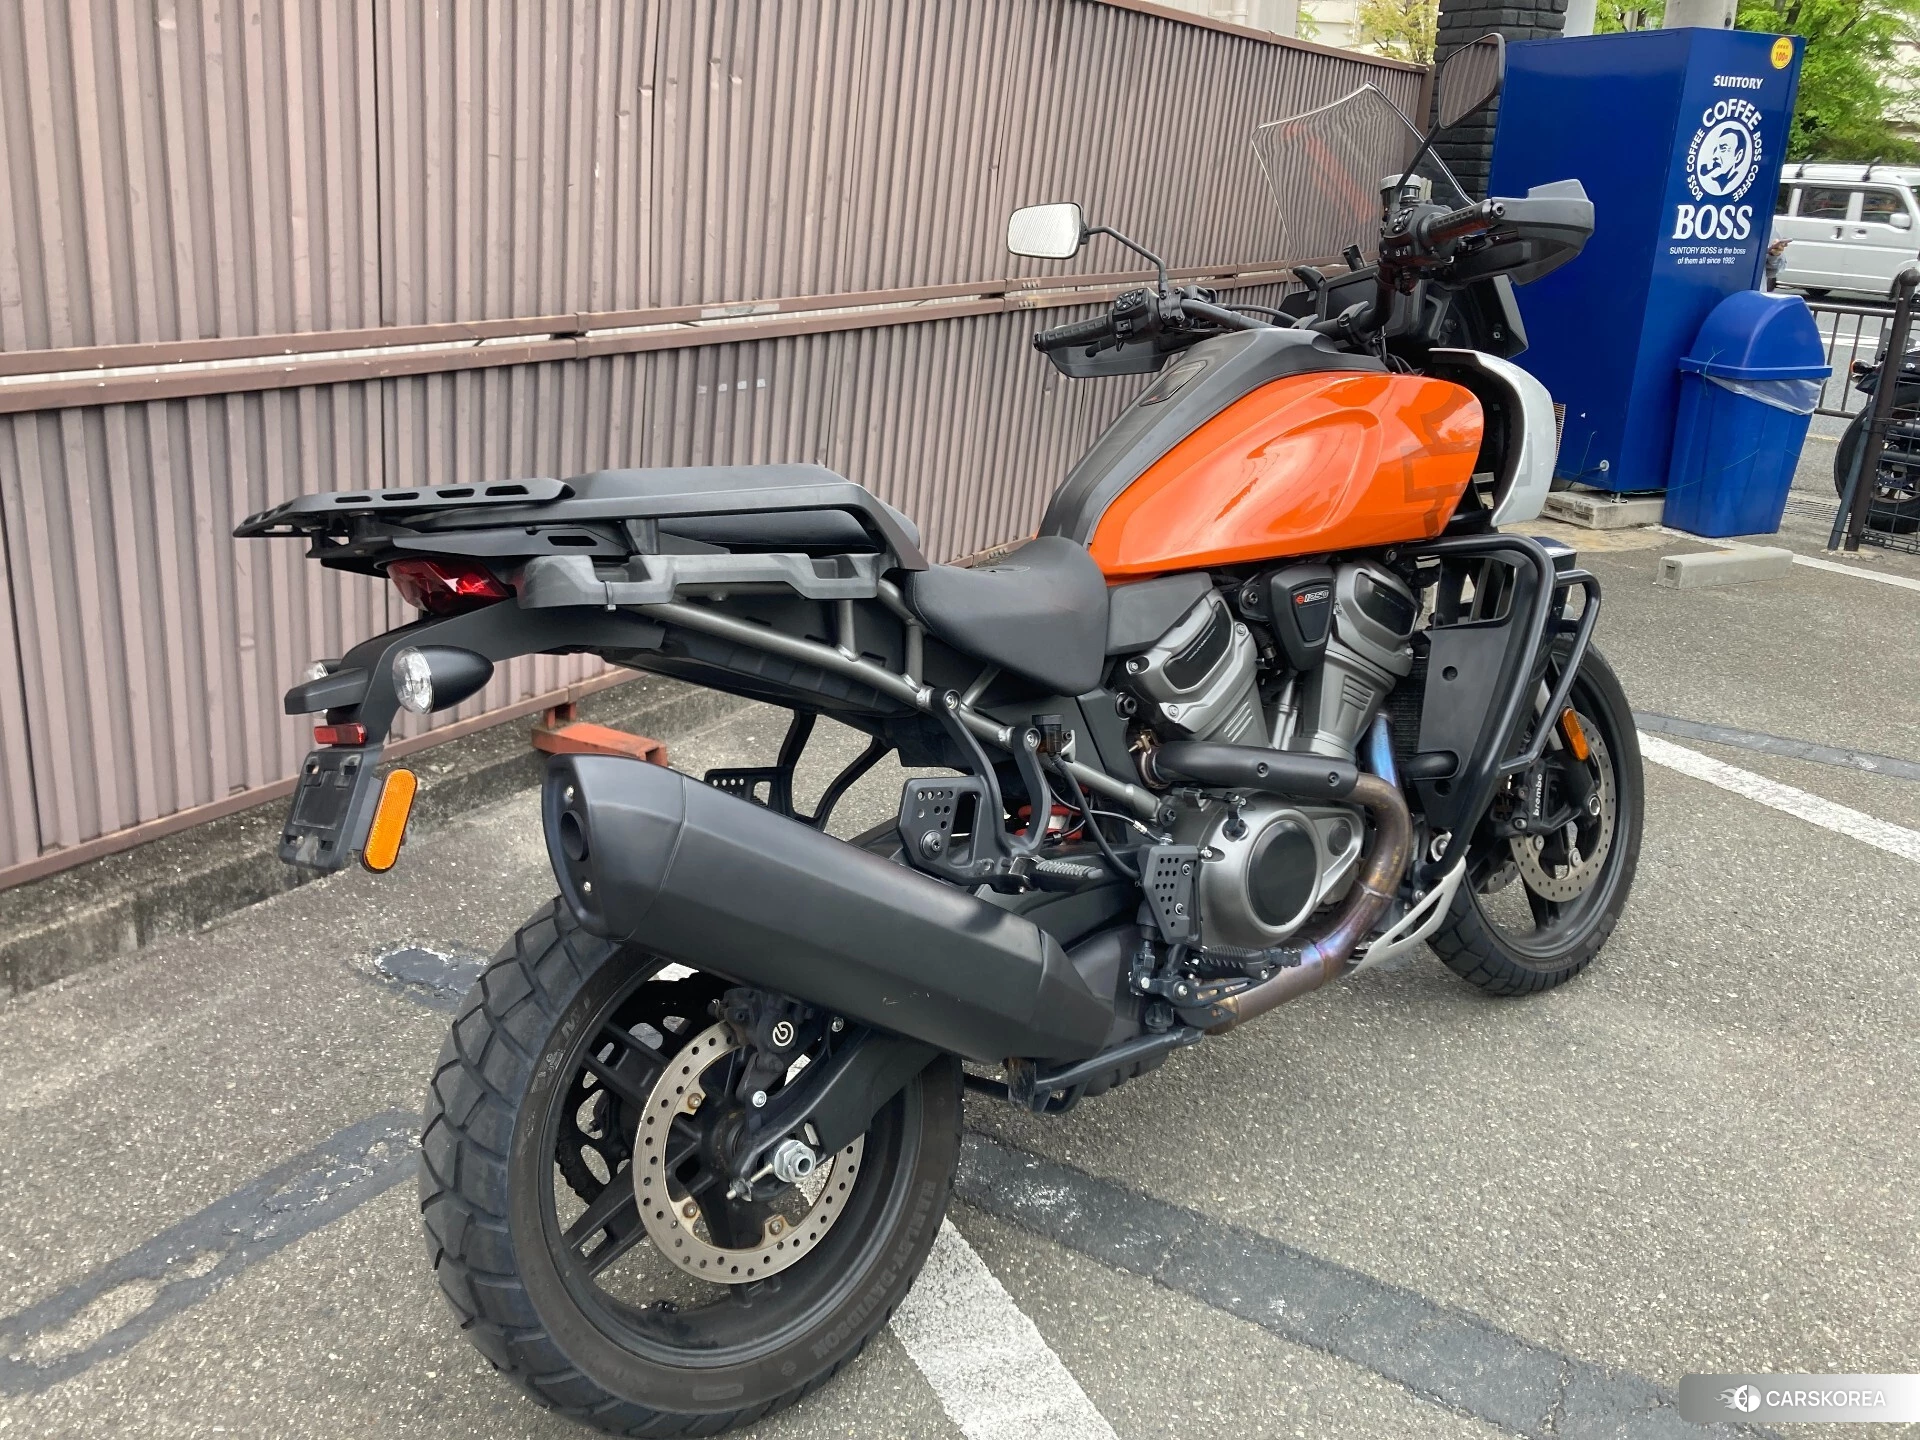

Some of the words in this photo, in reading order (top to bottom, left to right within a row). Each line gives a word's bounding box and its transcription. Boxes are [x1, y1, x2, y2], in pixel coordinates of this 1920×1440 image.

[1713, 74, 1763, 90] SUNTORY
[1702, 98, 1762, 131] COFFEE
[1686, 128, 1706, 173] COFFEE
[1752, 130, 1762, 162] BOSS
[1687, 174, 1704, 202] BOSS
[1732, 164, 1759, 202] COFFEE
[1672, 204, 1753, 240] BOSS
[1669, 246, 1700, 255] SUNTORY
[1700, 246, 1718, 255] BOSS
[1717, 246, 1723, 255] is
[1723, 246, 1733, 255] the
[1733, 246, 1747, 255] boss
[1677, 256, 1684, 265] of
[1683, 256, 1698, 265] them
[1698, 256, 1706, 265] all
[1706, 256, 1722, 265] since
[1304, 589, 1330, 603] 1250
[1532, 773, 1543, 817] brembo
